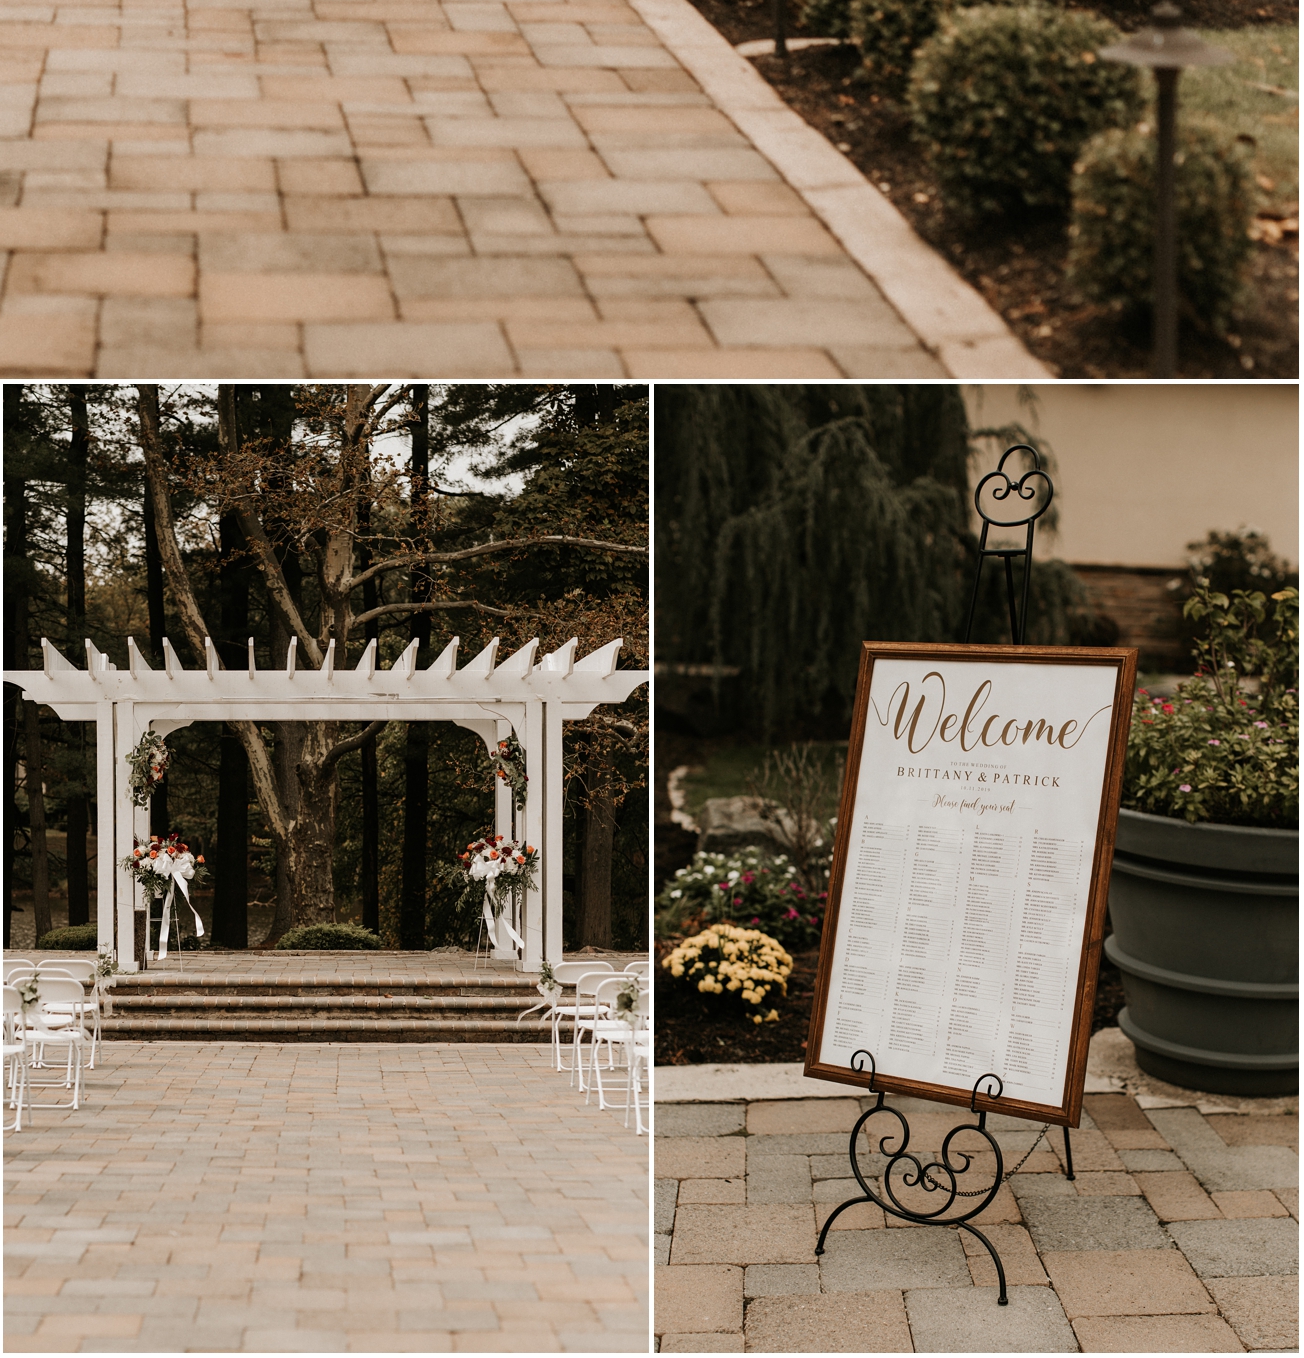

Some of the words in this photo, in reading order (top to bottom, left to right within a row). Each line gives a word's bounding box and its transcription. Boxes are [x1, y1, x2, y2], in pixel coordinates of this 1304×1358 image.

[870, 671, 1113, 754] Welcome
[896, 766, 973, 781] BRITTANY
[977, 771, 987, 783] &
[993, 772, 1061, 788] PATRICK
[932, 793, 958, 810] Please
[959, 796, 981, 814] find
[977, 803, 998, 816] your
[998, 799, 1016, 815] seat
